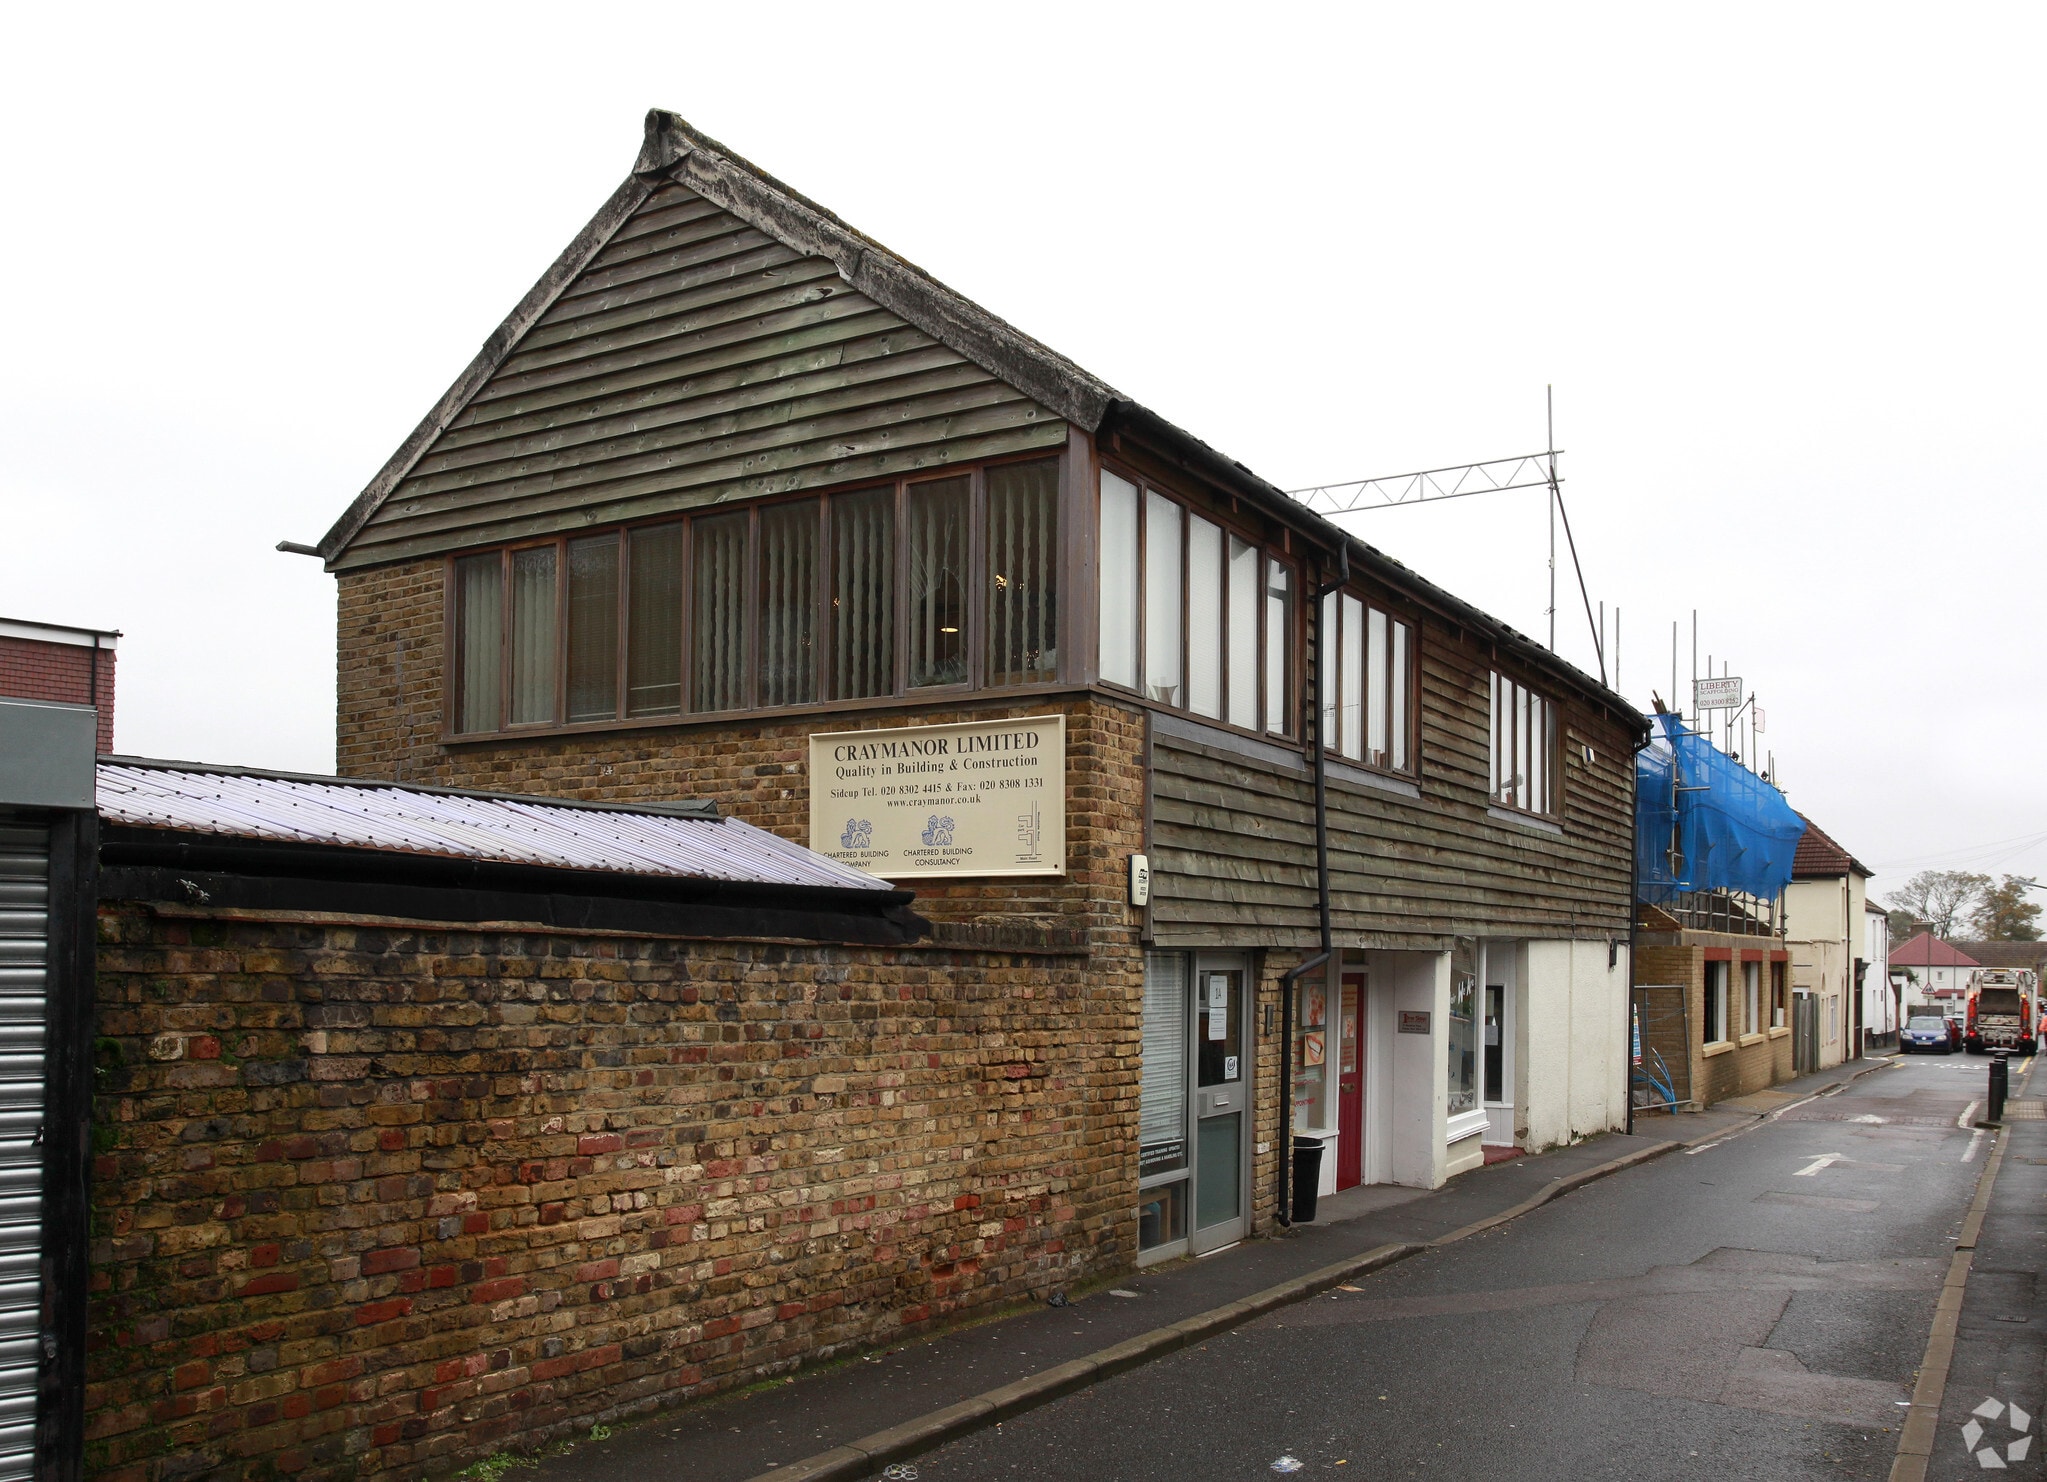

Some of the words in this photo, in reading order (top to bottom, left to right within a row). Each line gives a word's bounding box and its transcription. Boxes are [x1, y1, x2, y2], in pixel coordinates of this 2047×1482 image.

[1700, 681, 1738, 690] LIBERTY
[834, 738, 949, 762] CRAYMANOR
[957, 731, 1039, 754] LIMITED
[835, 765, 877, 780] Quality
[881, 764, 892, 775] in
[897, 760, 944, 774] Building
[949, 759, 958, 771] &
[963, 754, 1038, 770] Construction
[830, 788, 859, 799] Sidcup
[862, 787, 877, 797] Tel.
[881, 786, 896, 796] 020
[899, 784, 919, 795] 8302
[922, 783, 942, 793] 4415
[945, 782, 953, 792] &
[957, 781, 976, 792] Fax:
[979, 780, 996, 790] 020
[999, 779, 1021, 789] 8308
[1024, 777, 1043, 788] 1331
[887, 794, 981, 807] www.craymanor.co.uk
[823, 851, 858, 859] CHARTERED
[860, 850, 889, 858] BUILDING
[903, 849, 939, 857] CHARTERED
[942, 847, 973, 856] BUILDING
[915, 858, 960, 867] CONSULTANCY
